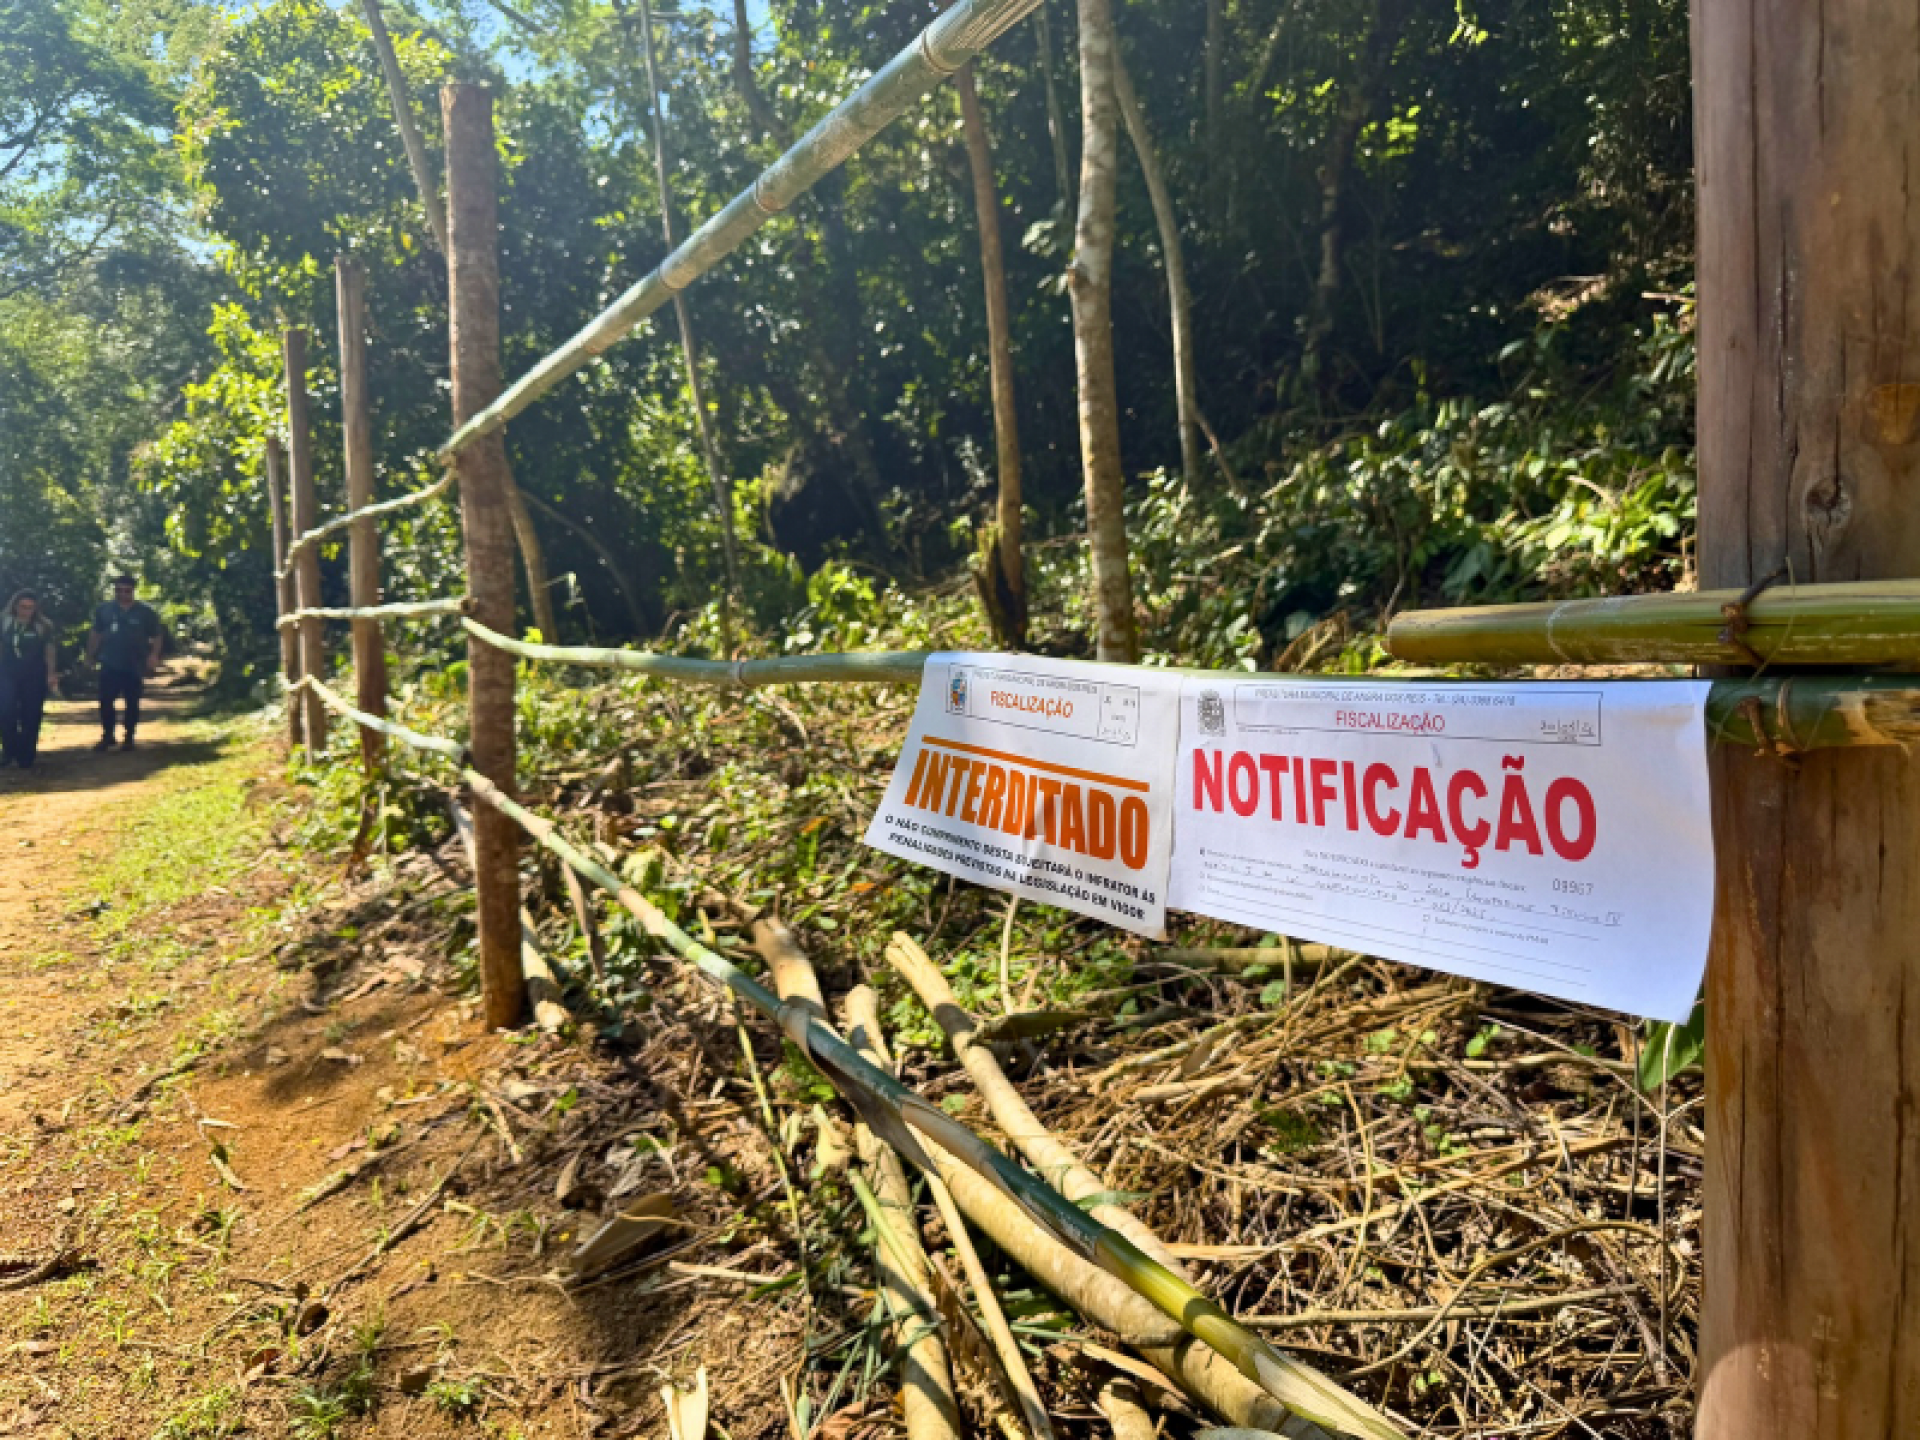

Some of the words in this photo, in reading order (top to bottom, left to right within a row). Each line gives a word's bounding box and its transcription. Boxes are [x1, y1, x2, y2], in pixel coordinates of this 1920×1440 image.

[991, 690, 1073, 720] FISCALIZAÇÃO
[1335, 709, 1446, 736] FISCALIZAÇÃO
[904, 748, 1150, 870] INTERDITADO
[1193, 748, 1597, 869] NOTIFICAÇÃO
